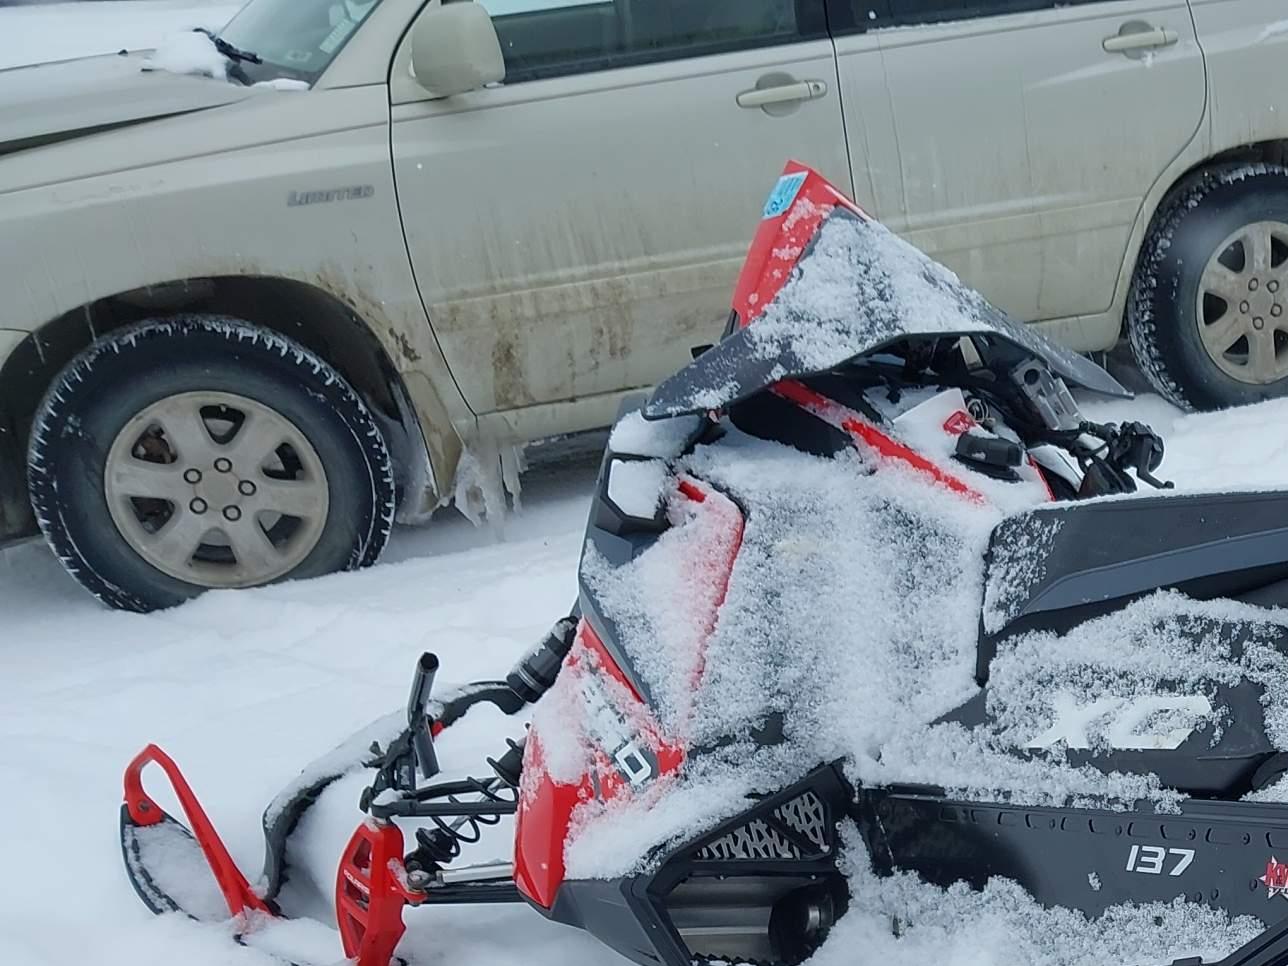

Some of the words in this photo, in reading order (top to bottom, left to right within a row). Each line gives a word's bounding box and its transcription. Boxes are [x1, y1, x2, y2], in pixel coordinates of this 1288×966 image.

[287, 184, 375, 207] LIMITED
[1022, 695, 1212, 750] XC
[1126, 844, 1196, 876] 137
